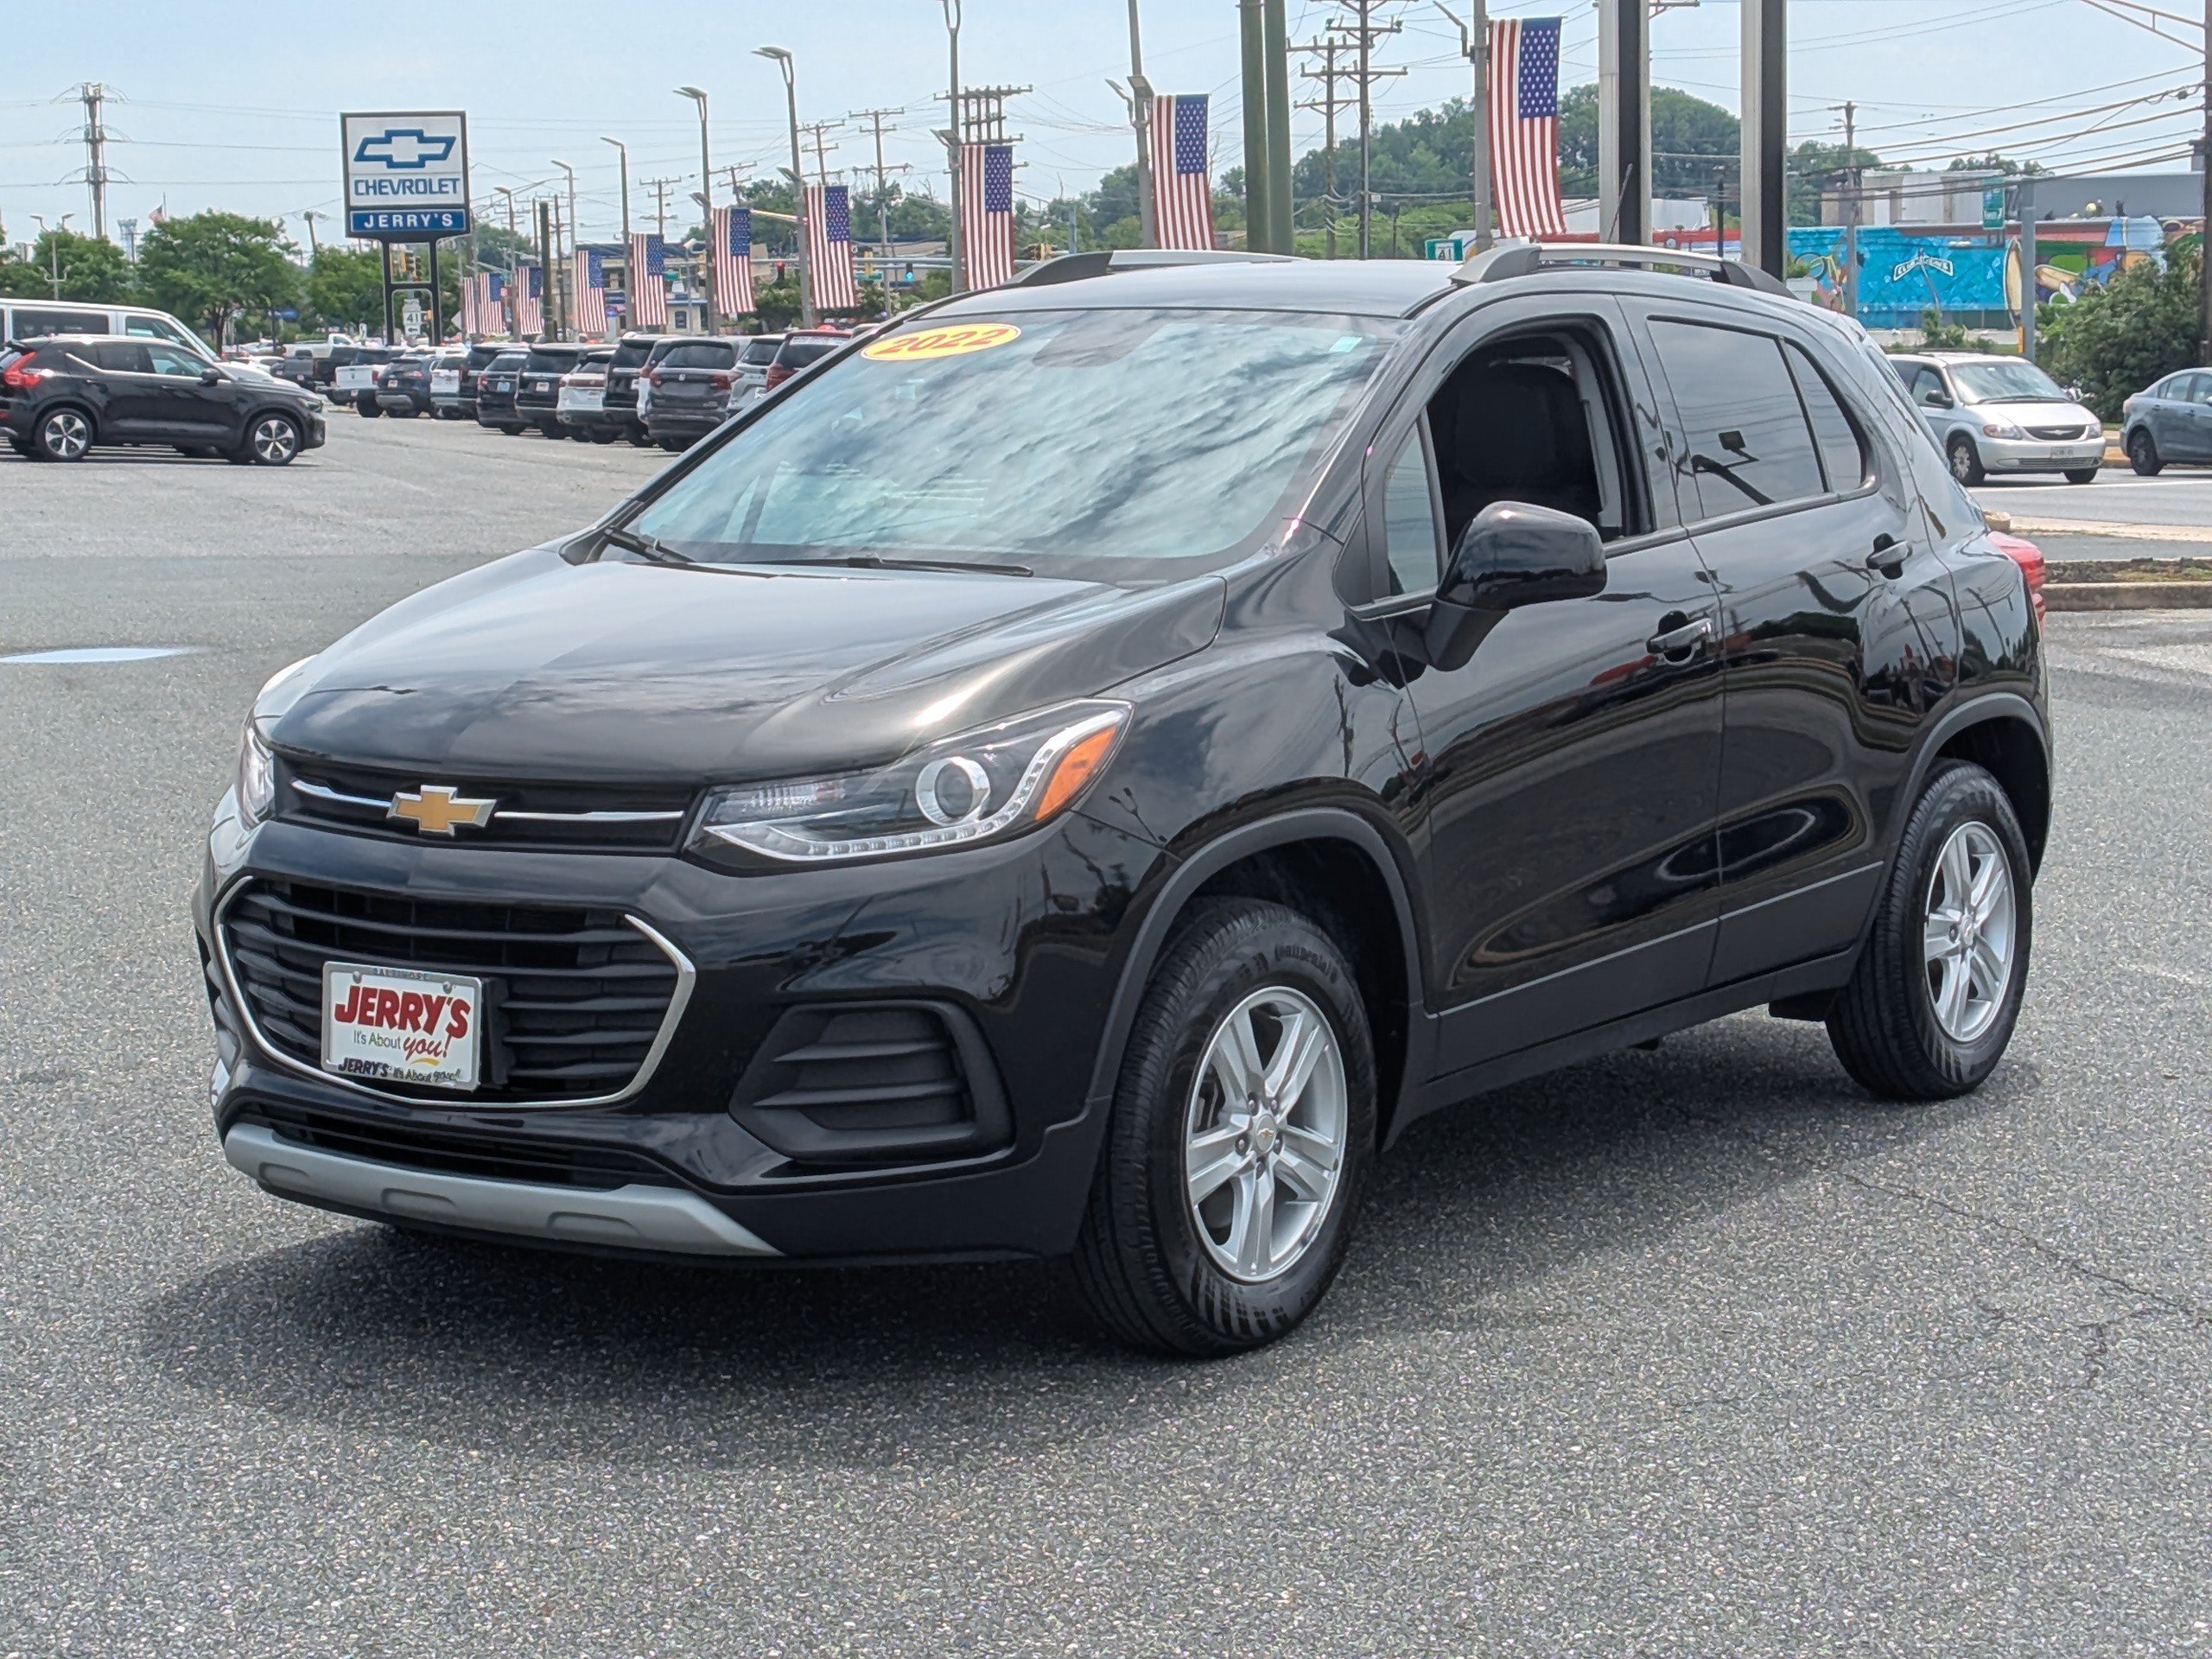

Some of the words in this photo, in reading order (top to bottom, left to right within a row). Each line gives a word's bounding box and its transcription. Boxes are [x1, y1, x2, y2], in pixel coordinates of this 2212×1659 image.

[354, 178, 460, 196] CHEVROLET
[364, 213, 453, 228] JERRY'S
[406, 313, 419, 323] 41
[874, 328, 1009, 355] 2022
[334, 985, 472, 1039] JERRY'S
[353, 1030, 367, 1045] It's
[368, 1032, 402, 1050] About
[403, 1035, 452, 1061] you!
[338, 1057, 390, 1077] JERRY'S
